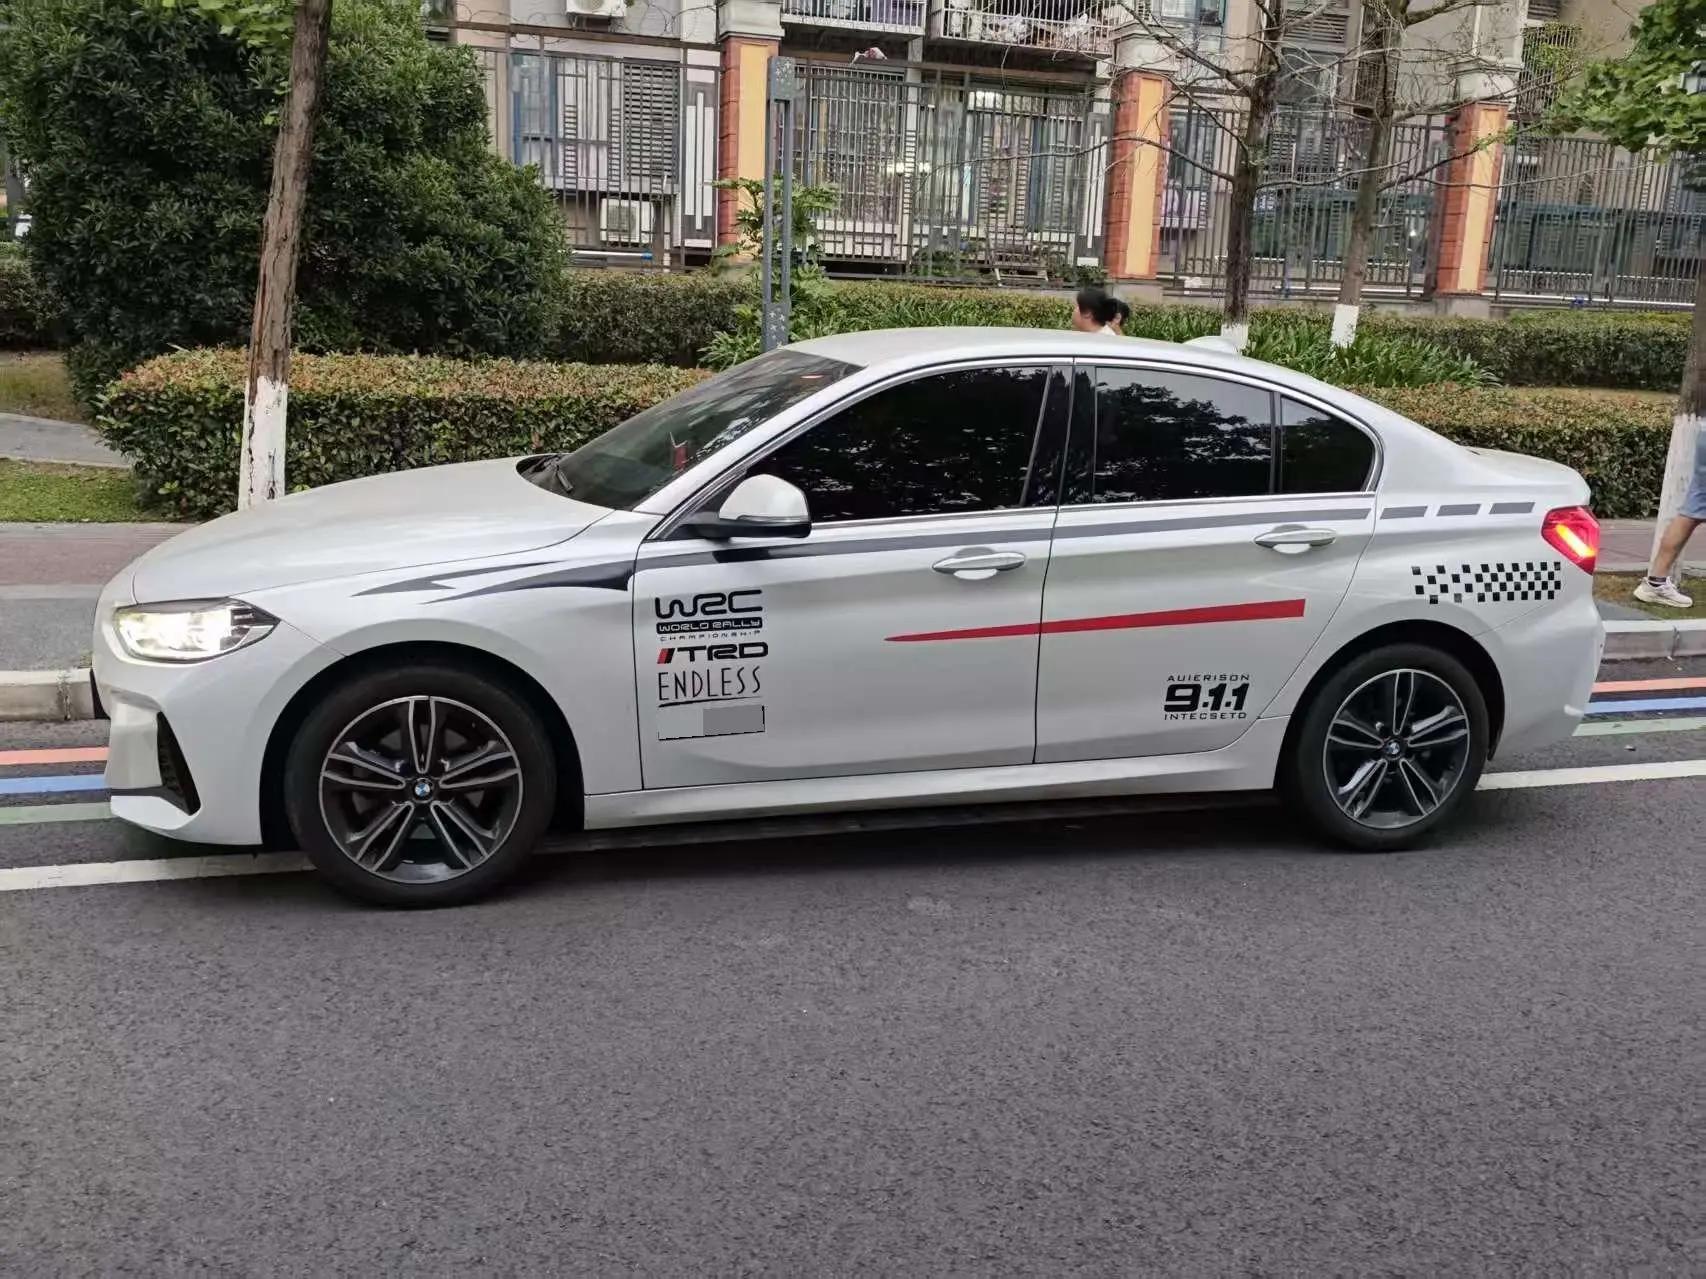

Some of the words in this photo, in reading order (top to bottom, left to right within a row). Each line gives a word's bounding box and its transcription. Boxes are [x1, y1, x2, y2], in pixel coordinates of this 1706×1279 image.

[655, 589, 763, 619] WRC
[659, 622, 710, 632] WORLD
[712, 618, 761, 629] RALLY
[660, 629, 761, 641] CHAMPIONSHIP
[658, 665, 761, 701] ENDLESS
